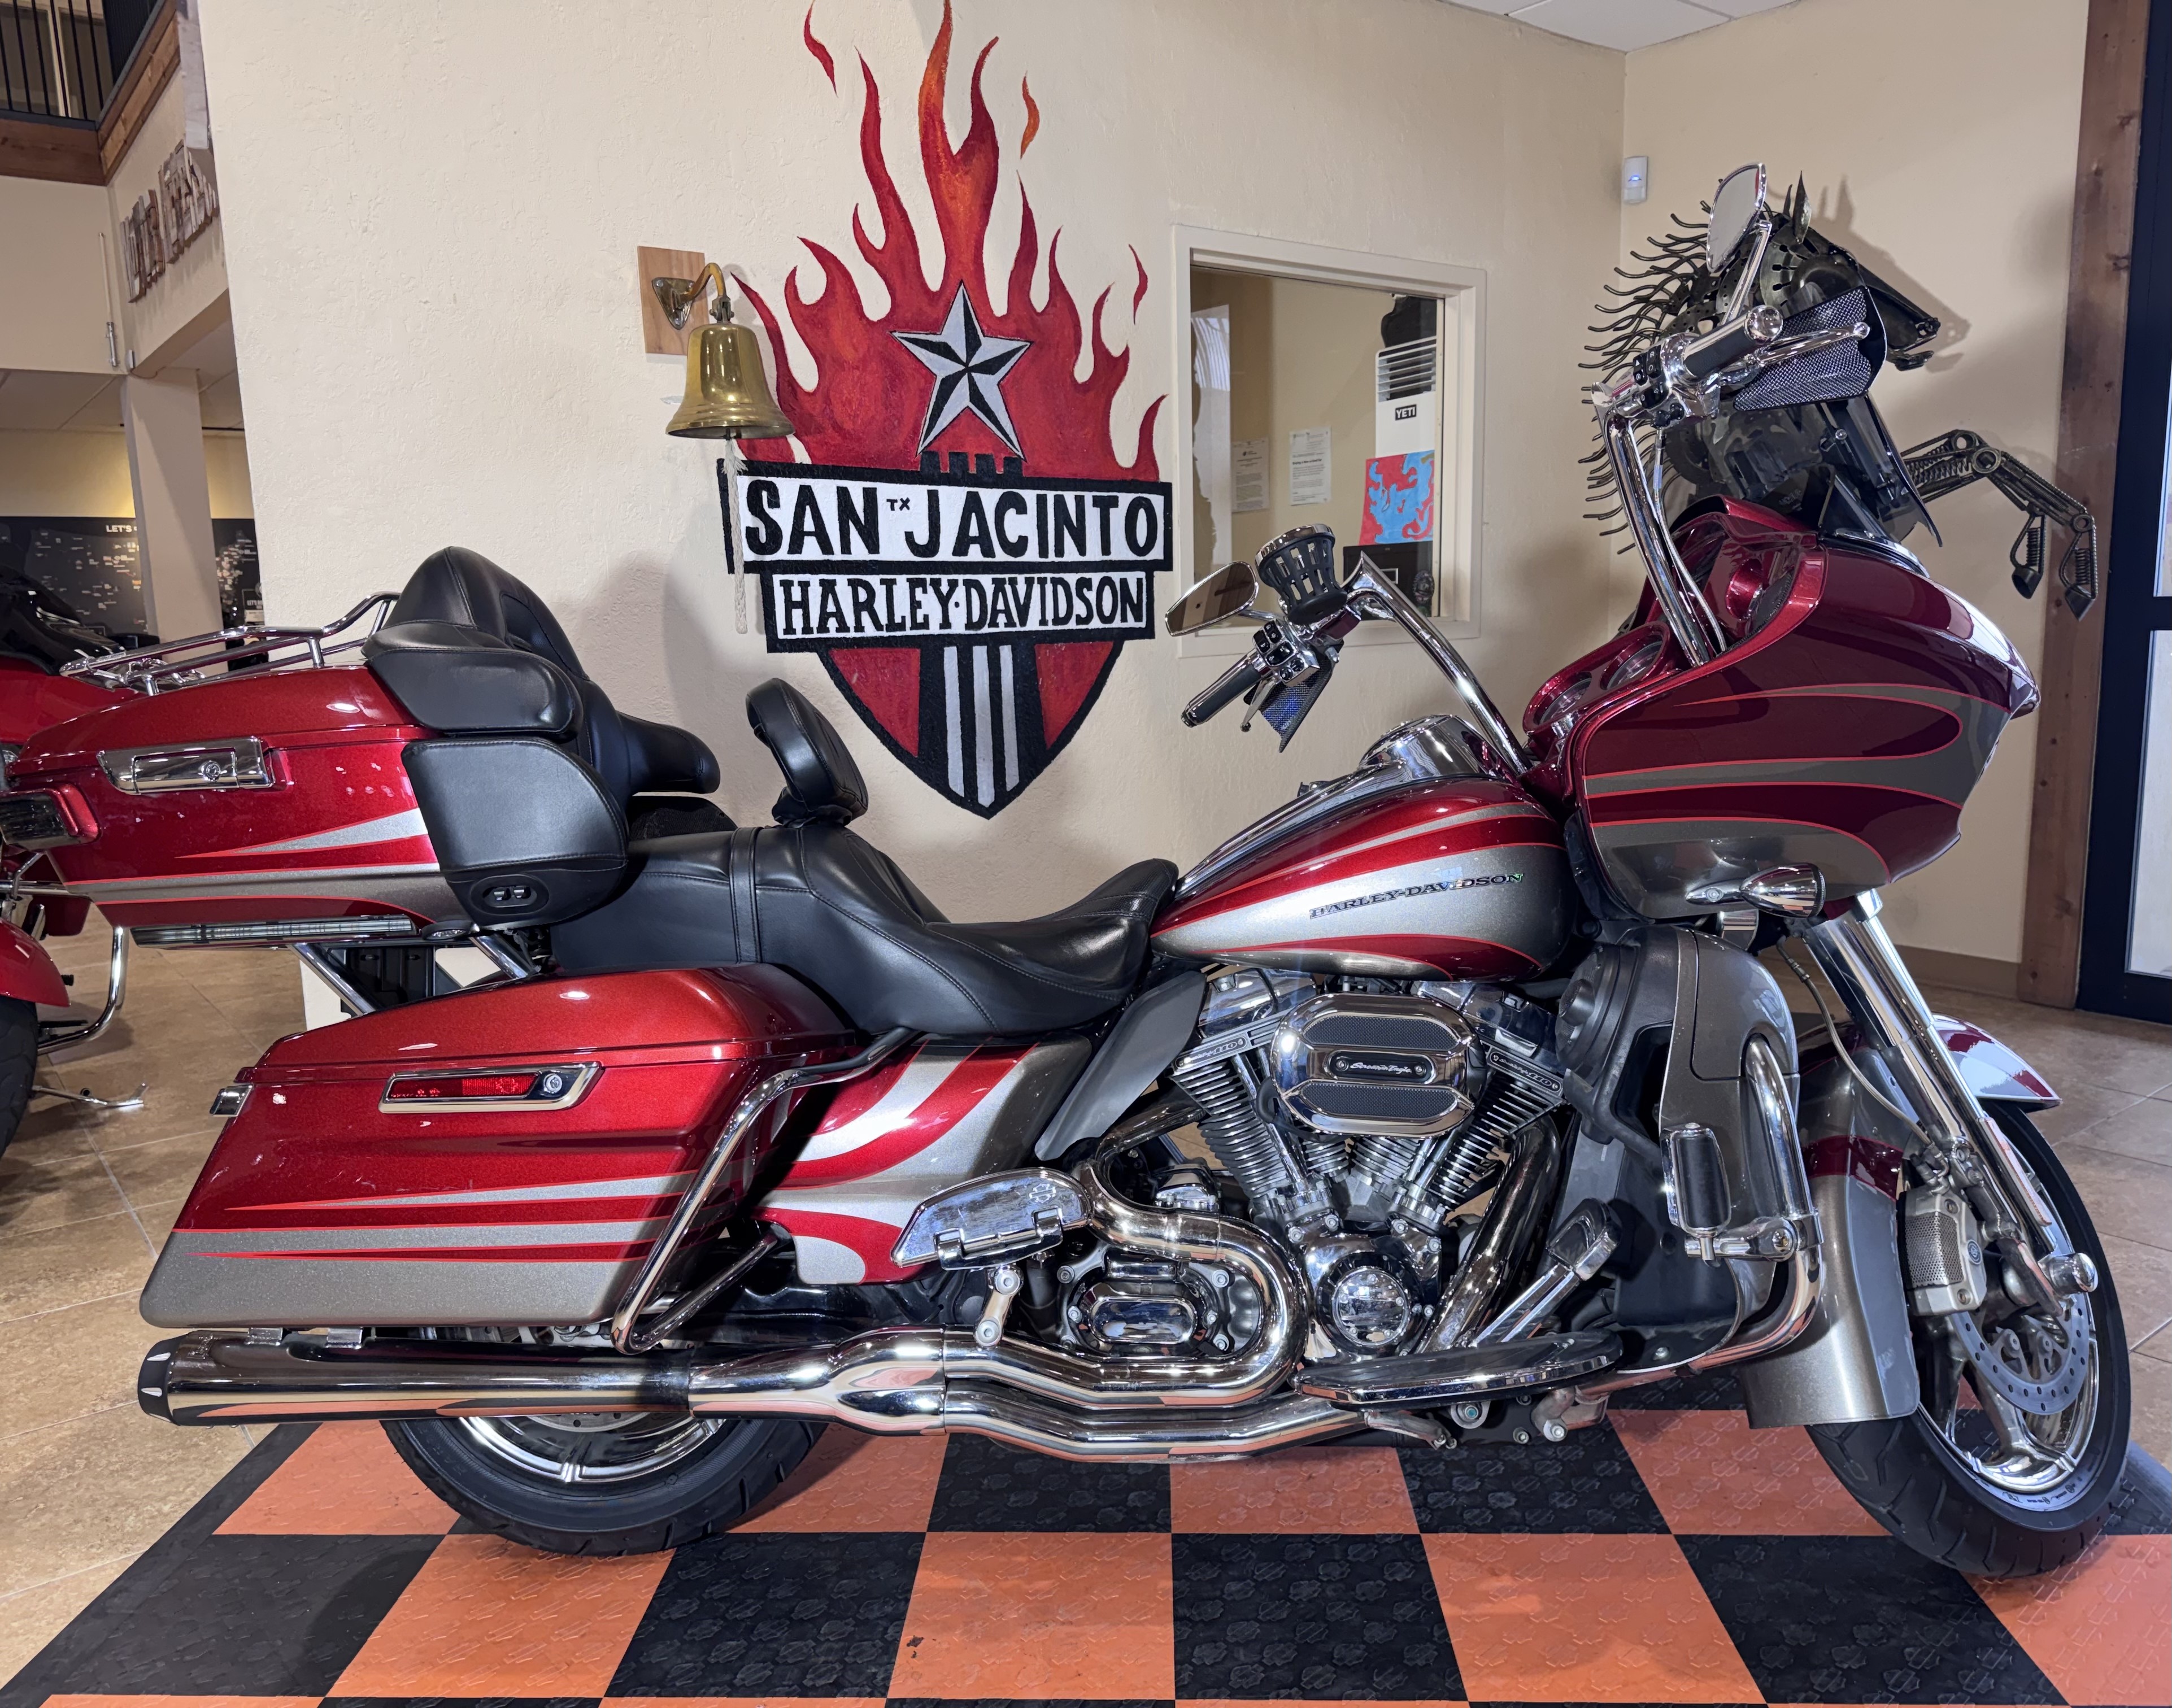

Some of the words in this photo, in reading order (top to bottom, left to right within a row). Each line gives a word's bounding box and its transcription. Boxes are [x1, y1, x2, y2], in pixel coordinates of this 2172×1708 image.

[1396, 406, 1416, 419] YETI
[745, 480, 880, 556] SAN
[886, 498, 911, 512] TX
[904, 488, 1160, 559] JACINTO
[1309, 873, 1525, 919] HARLEY-DAVIDSON
